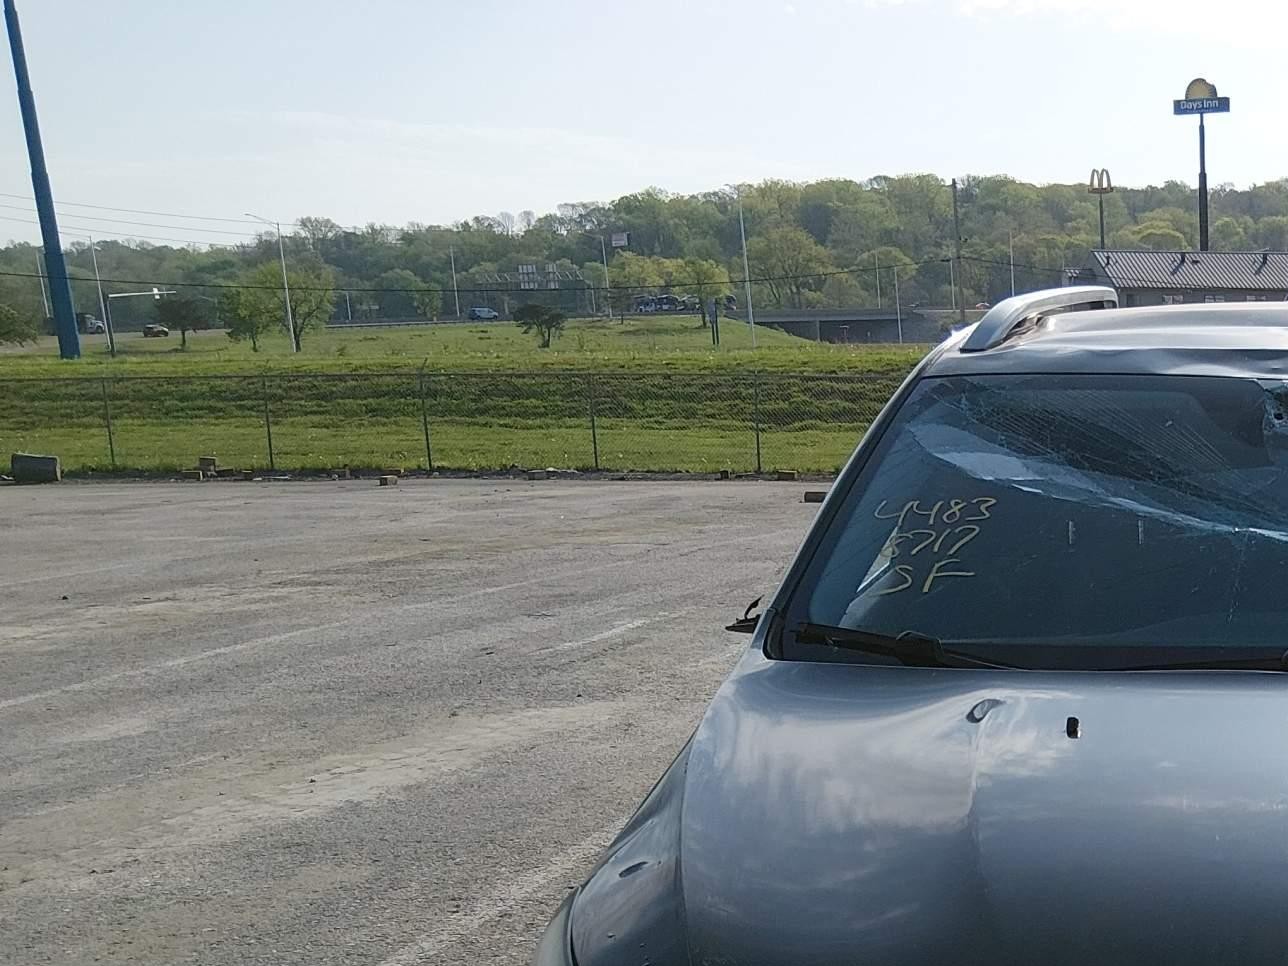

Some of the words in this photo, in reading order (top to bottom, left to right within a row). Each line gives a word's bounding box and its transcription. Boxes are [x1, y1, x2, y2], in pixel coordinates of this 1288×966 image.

[1180, 100, 1203, 110] Days
[1203, 99, 1219, 109] Inn
[874, 496, 998, 526] 4483
